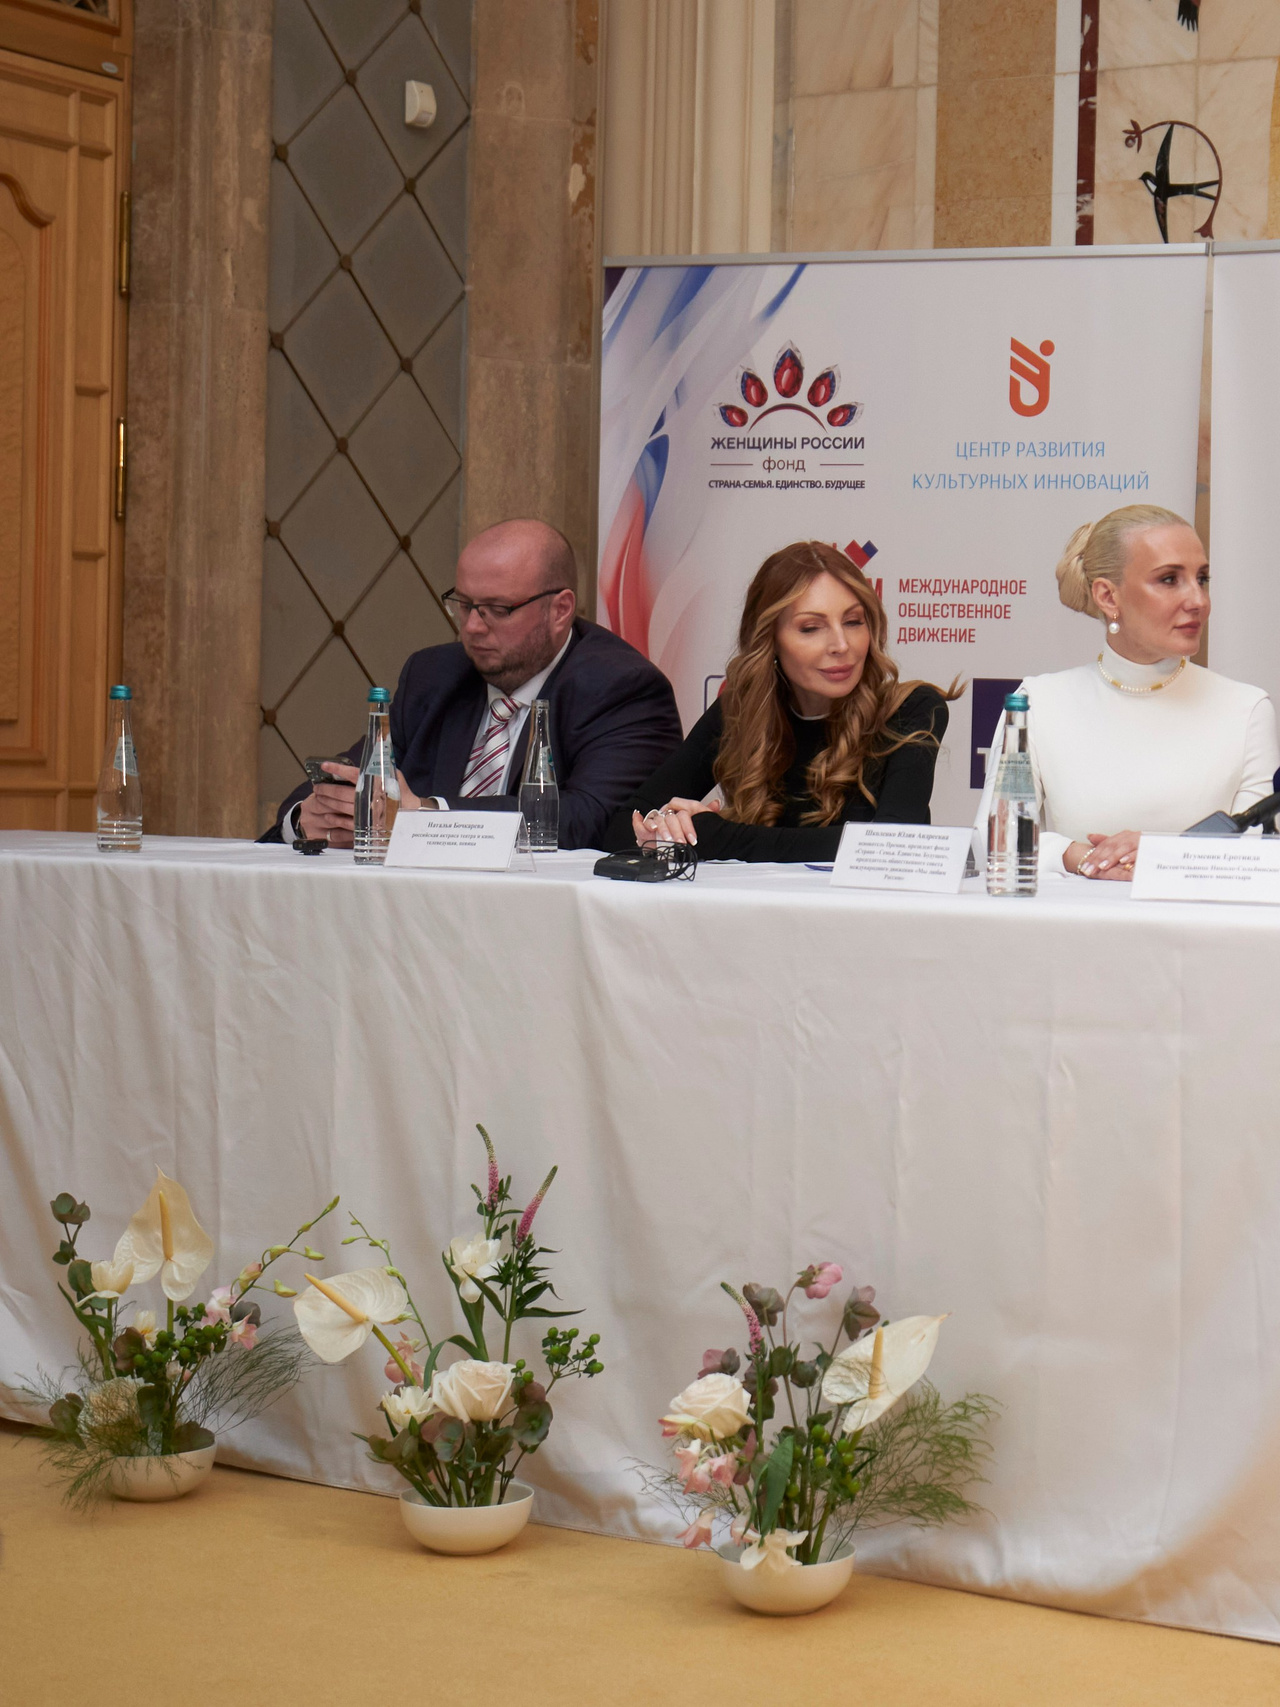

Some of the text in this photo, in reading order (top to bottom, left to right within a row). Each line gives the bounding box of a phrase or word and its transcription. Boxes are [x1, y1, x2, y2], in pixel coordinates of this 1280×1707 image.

[711, 436, 865, 451] ЖЕНЩИНЫ РОССИИ
[956, 441, 1105, 460] ЦЕНТР РАЗВИТИЯ
[762, 456, 806, 474] фонд
[708, 479, 866, 490] СТРАНА-СЕМЬЯ. ЕДИНСТВО. БУДУЩЕЕ
[912, 470, 1149, 493] КУЛЬТУРНЫХ ИННОВАЦИЙ
[898, 578, 1027, 597] МЕЖДУНАРОДНОЕ
[898, 603, 1011, 620] ОБЩЕСТВЕННОЕ
[897, 627, 976, 644] ДВИЖЕНИЕ
